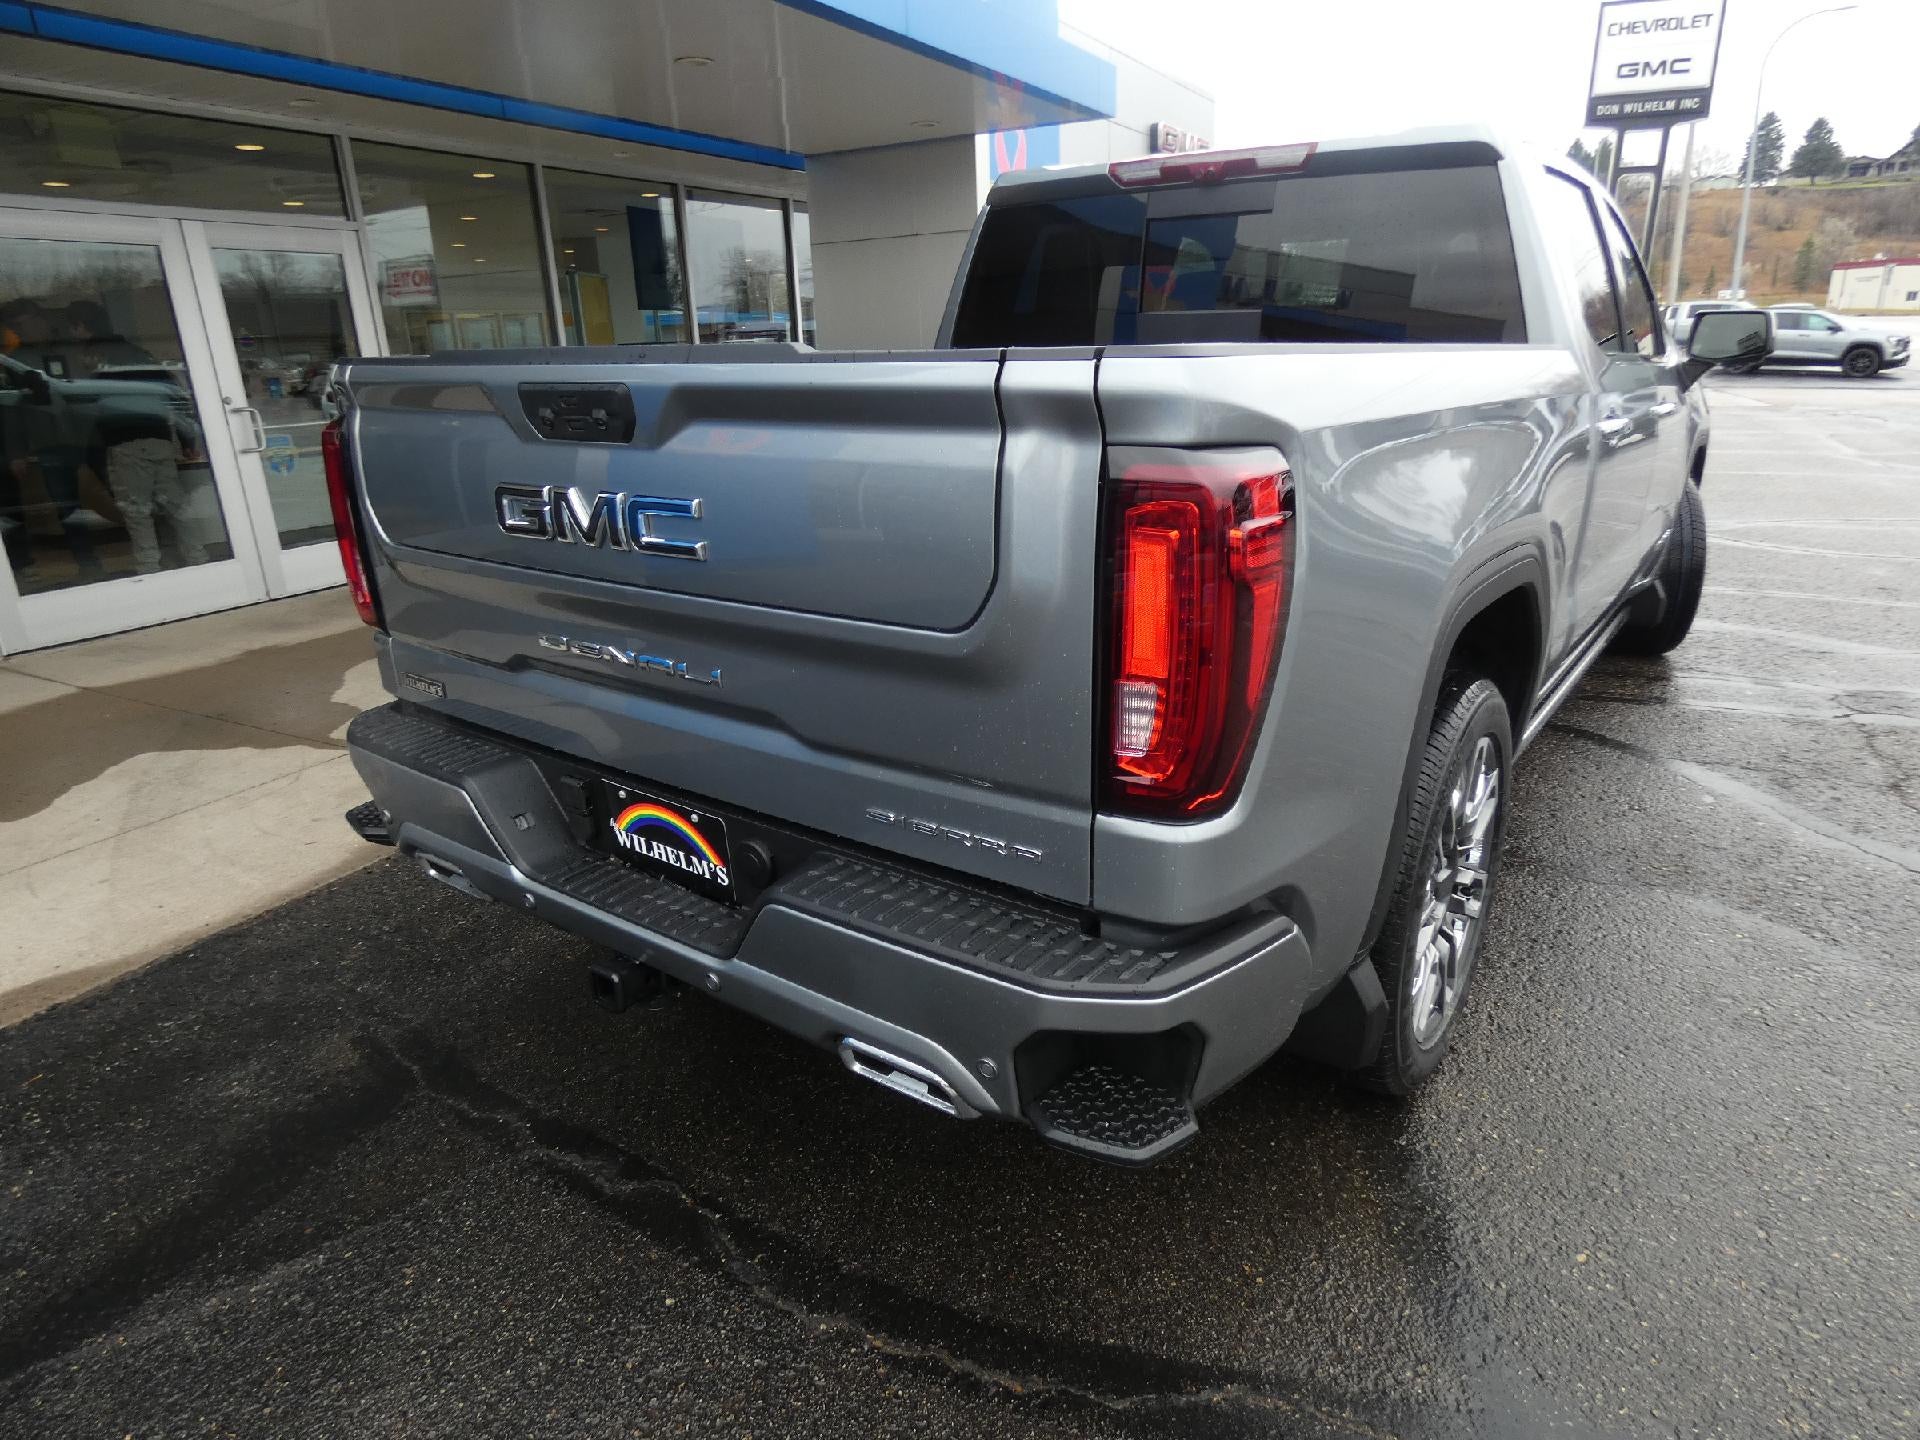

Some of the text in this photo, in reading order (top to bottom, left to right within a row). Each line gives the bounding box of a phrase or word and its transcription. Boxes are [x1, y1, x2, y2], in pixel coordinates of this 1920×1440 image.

[1607, 13, 1714, 37] CHEVROLET
[1617, 57, 1692, 79] GMC
[1596, 97, 1700, 116] DON WILHELM INC
[495, 481, 709, 562] GMC
[537, 632, 723, 688] DENALI
[614, 827, 730, 887] WILHELM'S
[864, 807, 1043, 865] SIERRA
